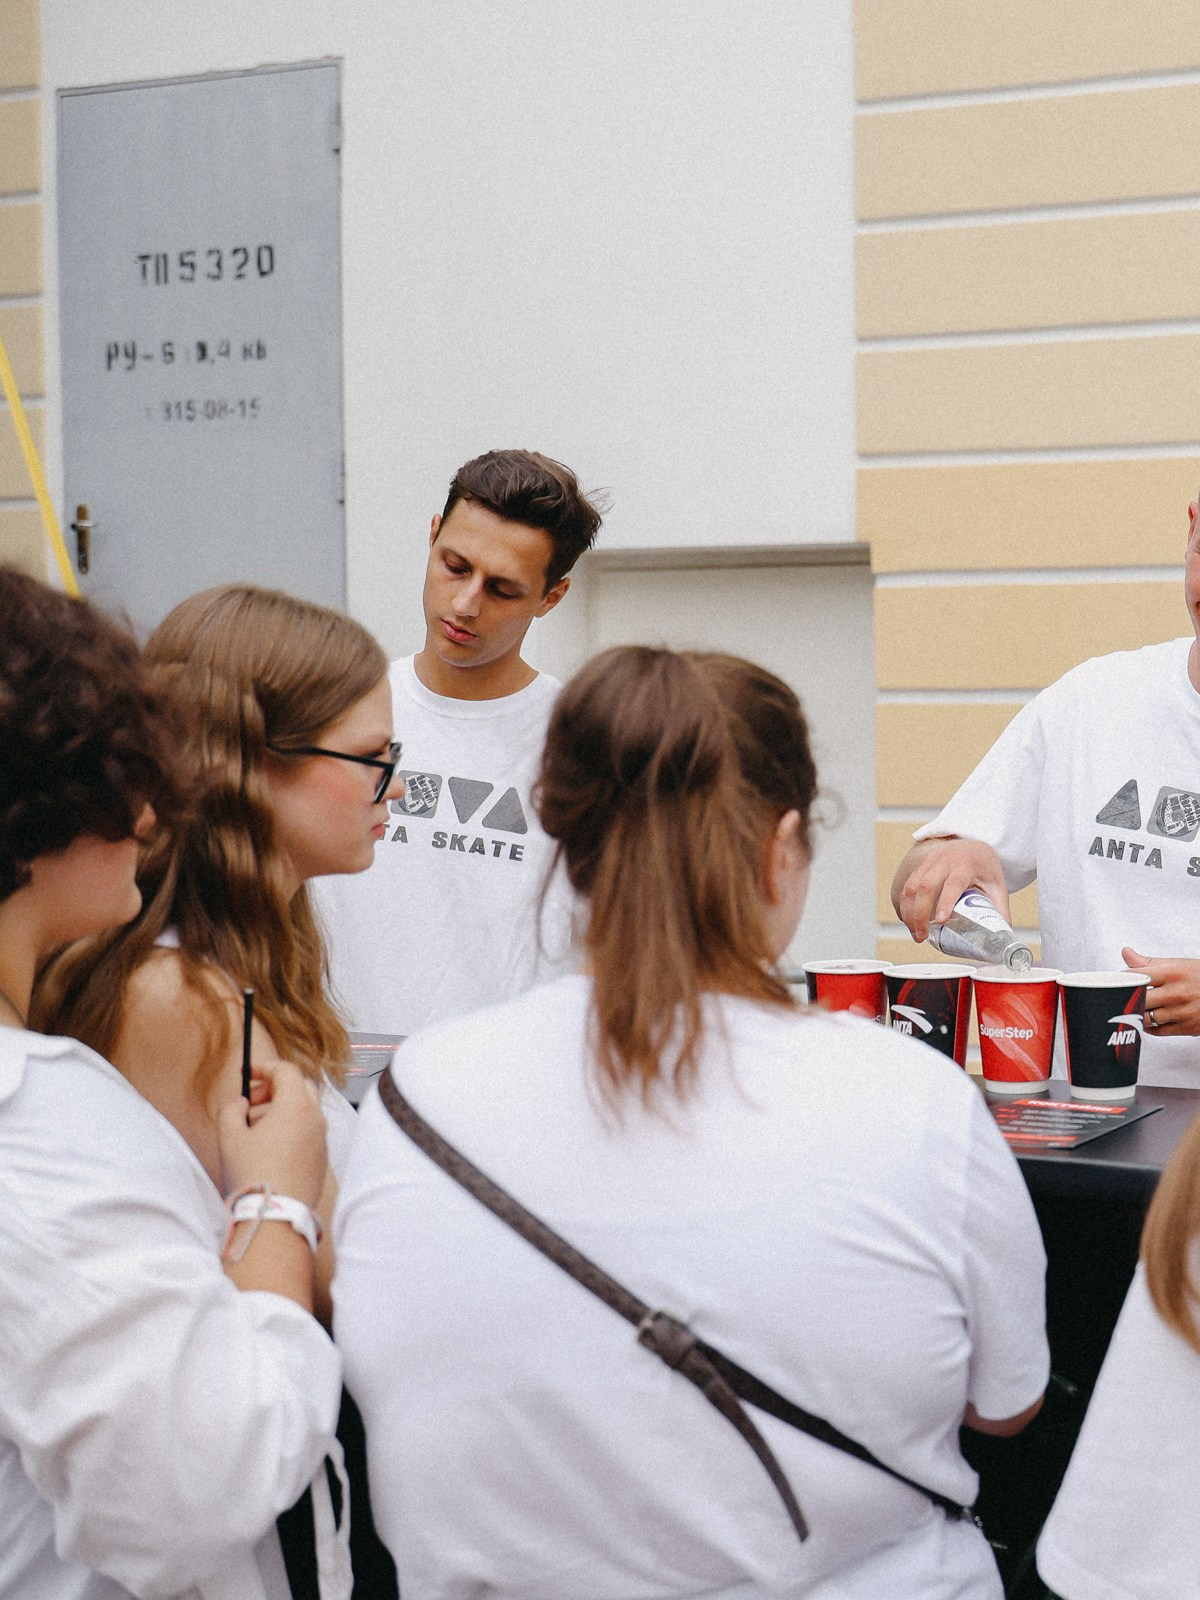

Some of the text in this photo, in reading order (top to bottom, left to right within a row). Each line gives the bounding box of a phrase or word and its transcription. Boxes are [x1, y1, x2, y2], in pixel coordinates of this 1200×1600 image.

[431, 831, 526, 862] SKATE
[1088, 836, 1163, 870] ANTA
[979, 1023, 1034, 1041] SuperStep
[1106, 1029, 1137, 1046] ANTA
